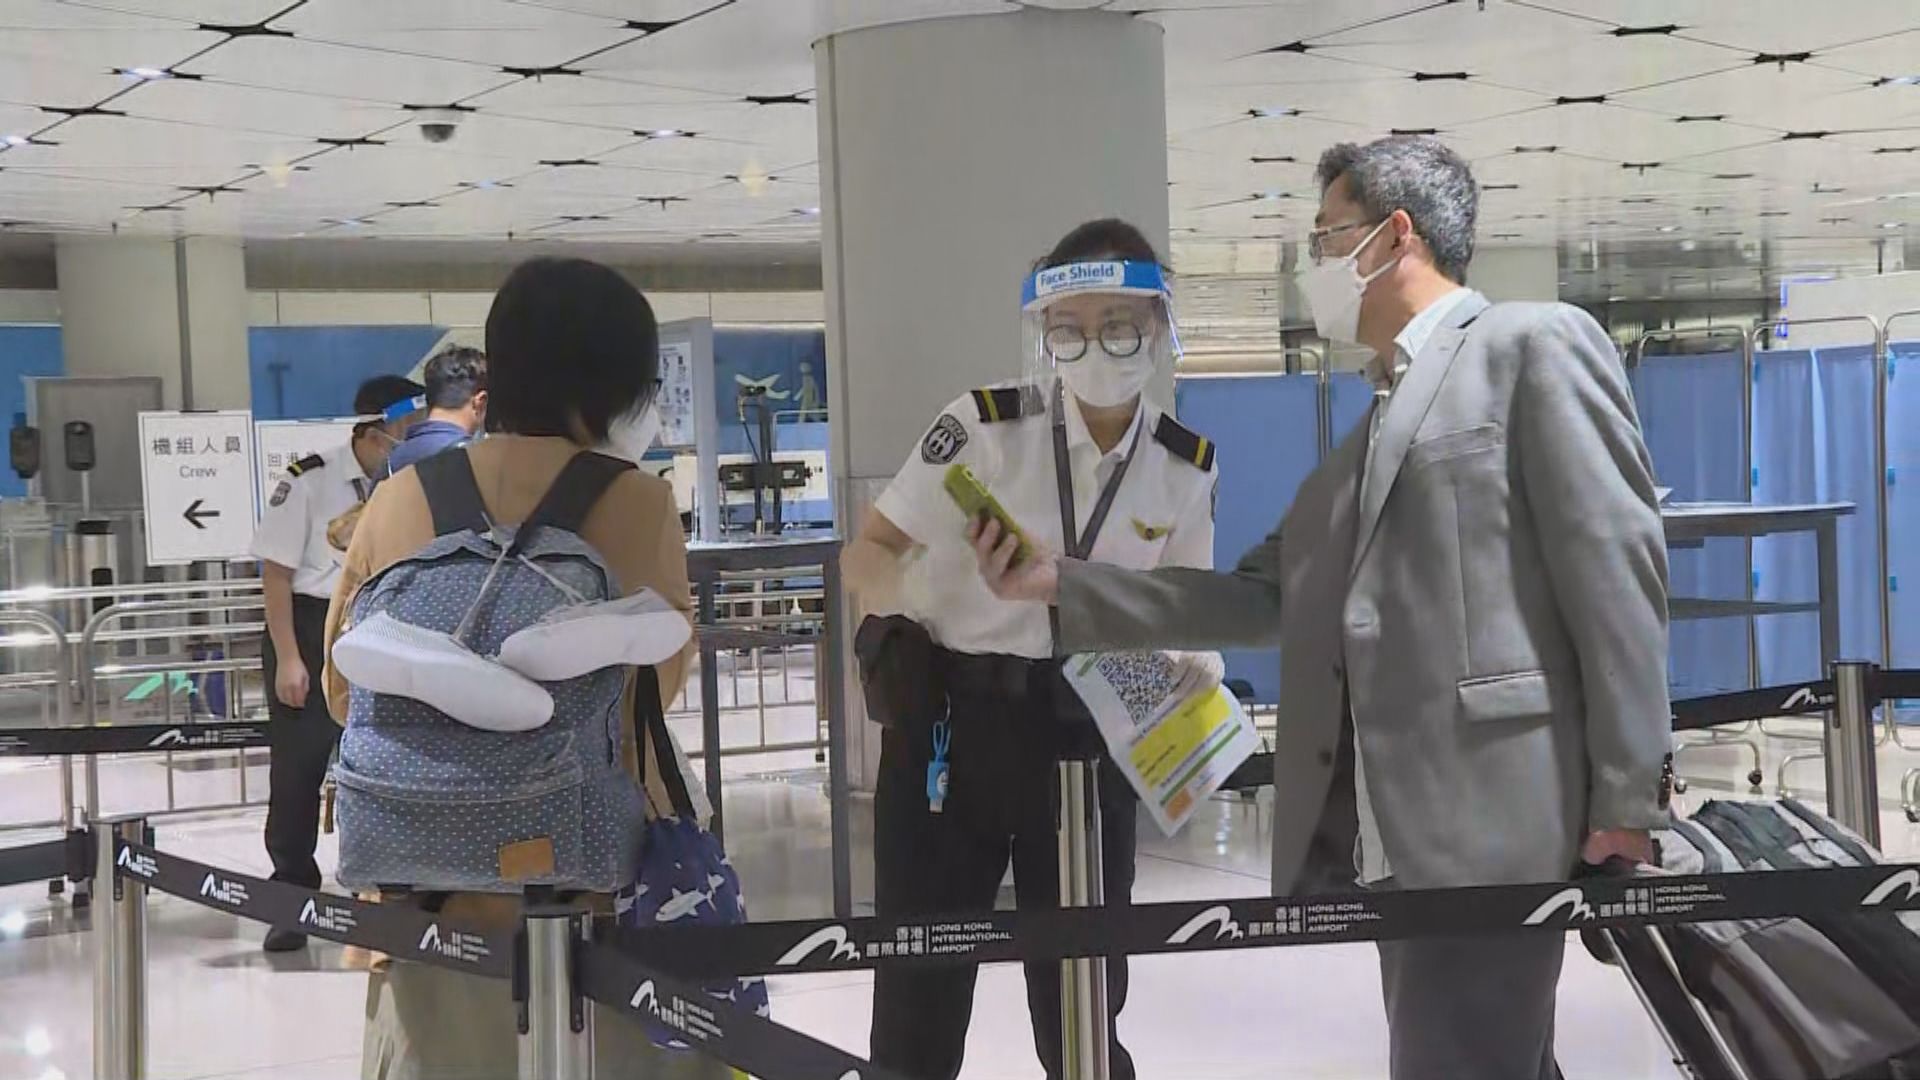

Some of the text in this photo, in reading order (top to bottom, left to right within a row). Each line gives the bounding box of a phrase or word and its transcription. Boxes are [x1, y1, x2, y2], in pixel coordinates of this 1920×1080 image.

[1041, 272, 1066, 286] Face
[1070, 264, 1114, 279] Shield
[153, 436, 241, 455] 機組人員
[179, 465, 217, 478] Crew
[1682, 884, 1708, 892] KONG
[1655, 893, 1727, 903] INTERNATIONAL
[1308, 903, 1363, 913] HONG KONG
[1655, 904, 1695, 913] AIRPORT
[1308, 912, 1382, 923] INTERNATIONAL
[896, 926, 924, 940] 香港
[931, 922, 992, 933] HONG KONG
[1308, 924, 1348, 933] AIRPORT
[931, 932, 1013, 943] INTERNATIONAL
[931, 944, 976, 953] AIRPORT
